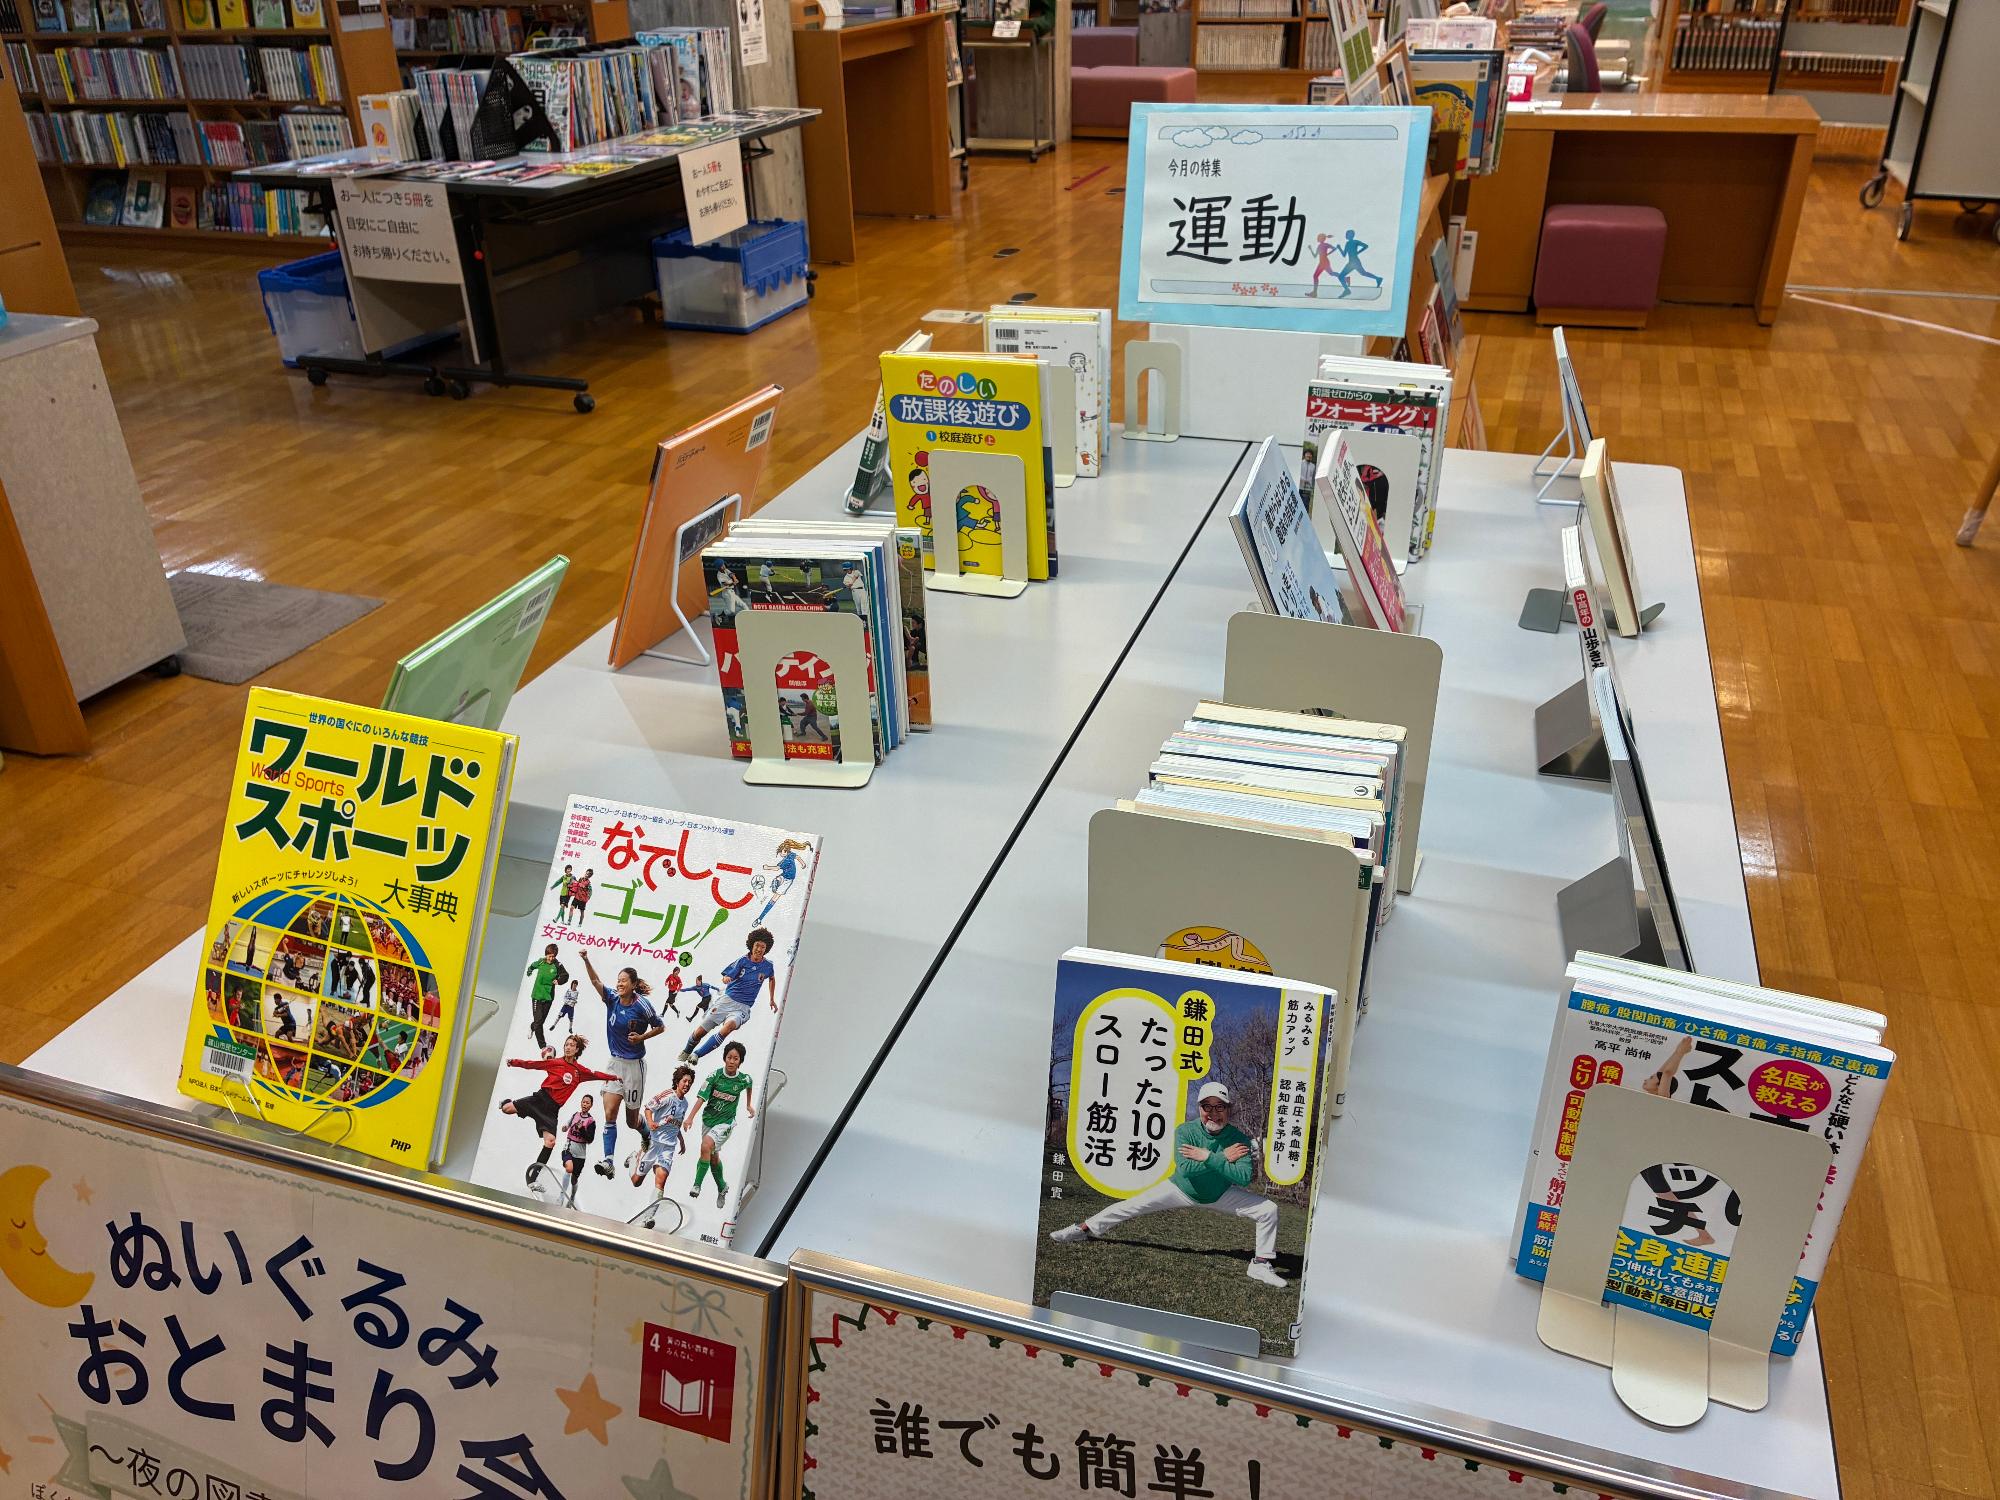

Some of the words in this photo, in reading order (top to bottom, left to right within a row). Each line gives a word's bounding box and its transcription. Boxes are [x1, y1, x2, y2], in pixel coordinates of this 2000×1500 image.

[1168, 158, 1222, 177] 今月の特集
[340, 190, 433, 208] お一人につき5冊を
[346, 216, 420, 234] 目安にご自由に
[1166, 193, 1307, 267] 運動
[352, 244, 451, 264] お持ち帰りください。
[919, 372, 996, 397] たのしい
[1312, 387, 1373, 401] 知識ゼロからの
[900, 397, 1019, 427] 放課後遊び
[1310, 398, 1420, 425] ウォーキング
[939, 431, 983, 444] 校庭遊び
[753, 603, 768, 611] BOYS
[796, 604, 824, 612] COACHING
[1575, 593, 1592, 624] 中高年の
[309, 712, 429, 747] 世界の国ぐにのいろんな競技
[784, 743, 831, 755] 法も充実!
[250, 718, 481, 819] ワールド
[251, 761, 290, 785] World
[295, 771, 345, 797] Sports
[237, 782, 471, 882] スポーツ
[601, 821, 754, 910] なでしこ
[232, 870, 358, 904] 新しいスポーツにチャレンジしよう!
[381, 878, 460, 923] 大事典
[593, 878, 729, 949] ゴール!
[541, 923, 678, 964] 女子のためのサッカーの本
[1179, 997, 1208, 1074] 鎌田式
[1284, 999, 1299, 1057] 筋力アップ
[1301, 1001, 1315, 1047] みるみる
[1594, 1040, 1621, 1053] 高平
[1625, 1046, 1652, 1060] 尚伸
[1575, 1058, 1592, 1085] こり
[1760, 1066, 1825, 1092] 名医が
[627, 1089, 638, 1103] 10
[1084, 1014, 1122, 1168] スロー筋活
[1126, 1016, 1168, 1171] たった10秒
[1755, 1085, 1817, 1113] 教える
[1273, 1078, 1292, 1164] 認知症を予防!
[1287, 1081, 1307, 1169] 高血圧・高血糖・
[1557, 1093, 1585, 1157] 可動域制限
[391, 1138, 412, 1153] PHP
[106, 1211, 499, 1390] ぬいぐるみ
[1607, 1267, 1718, 1306] つながりを意識し
[649, 1332, 661, 1353] 4
[666, 1347, 694, 1362] みんなに
